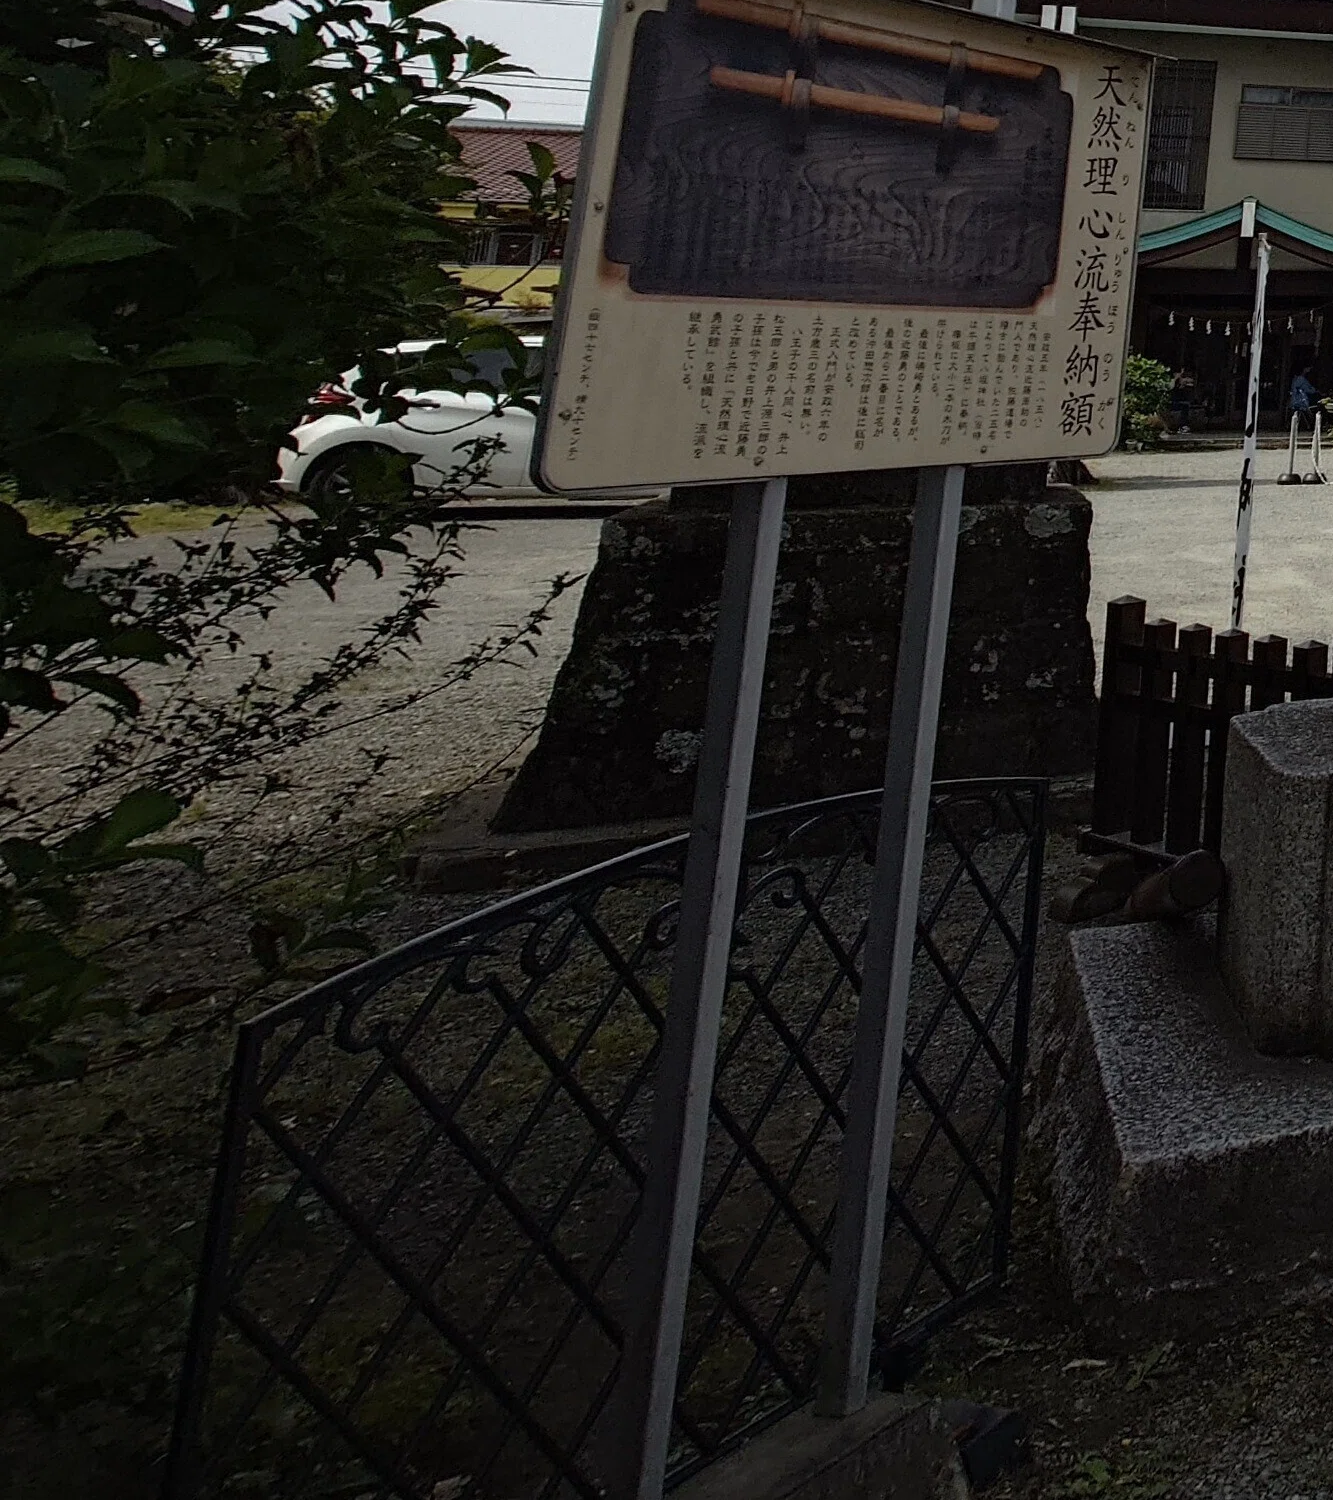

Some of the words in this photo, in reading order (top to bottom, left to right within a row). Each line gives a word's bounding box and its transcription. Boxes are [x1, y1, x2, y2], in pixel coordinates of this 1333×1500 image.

[1058, 66, 1126, 436] 天然理心流奉納額
